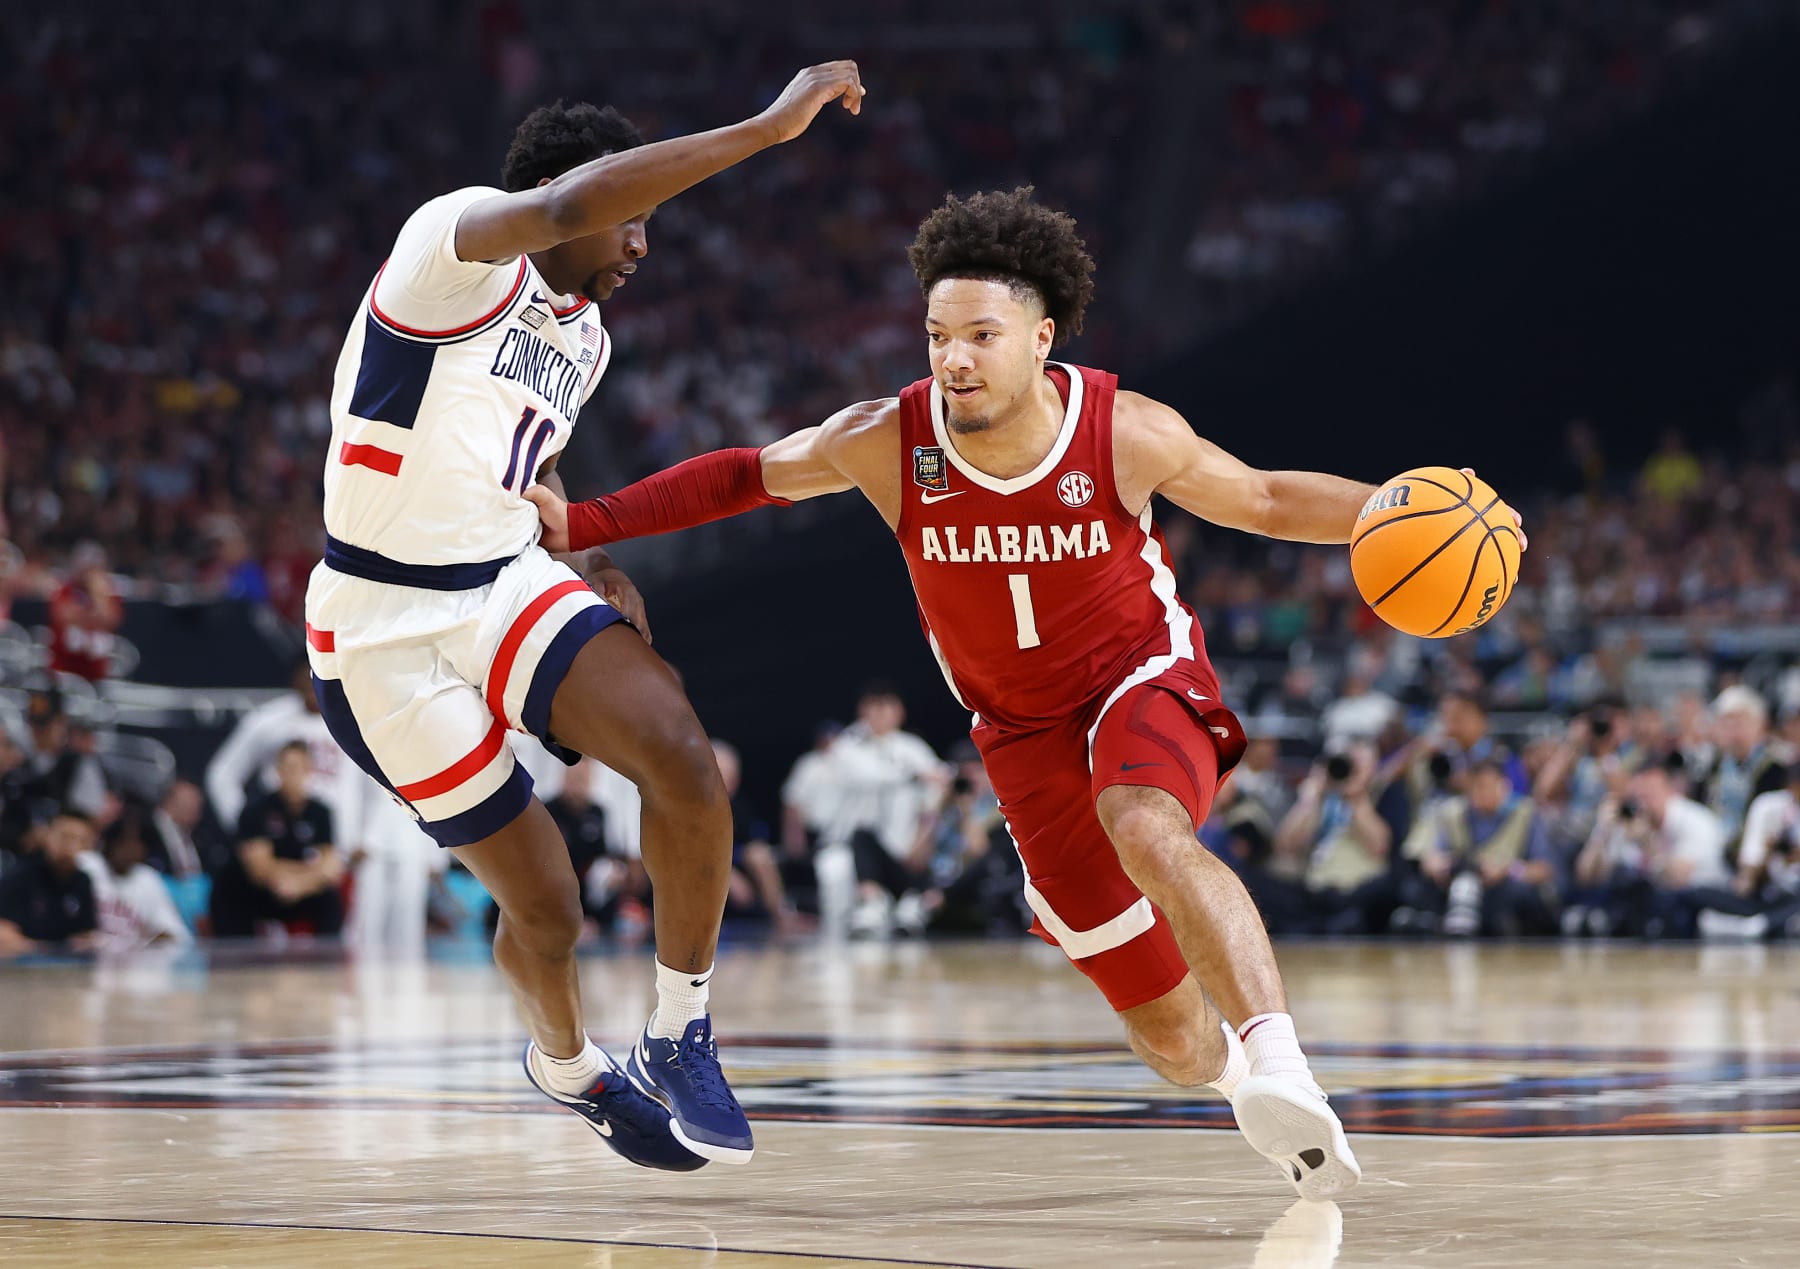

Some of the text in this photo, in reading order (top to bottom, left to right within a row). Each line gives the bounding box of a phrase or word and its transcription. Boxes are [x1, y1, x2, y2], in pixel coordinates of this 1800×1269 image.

[501, 405, 556, 497] 10
[919, 455, 939, 465] FINAL
[919, 464, 939, 473] FOUR
[1059, 472, 1092, 506] SEC
[921, 519, 1111, 562] ALABAMA
[1008, 574, 1041, 650] 1
